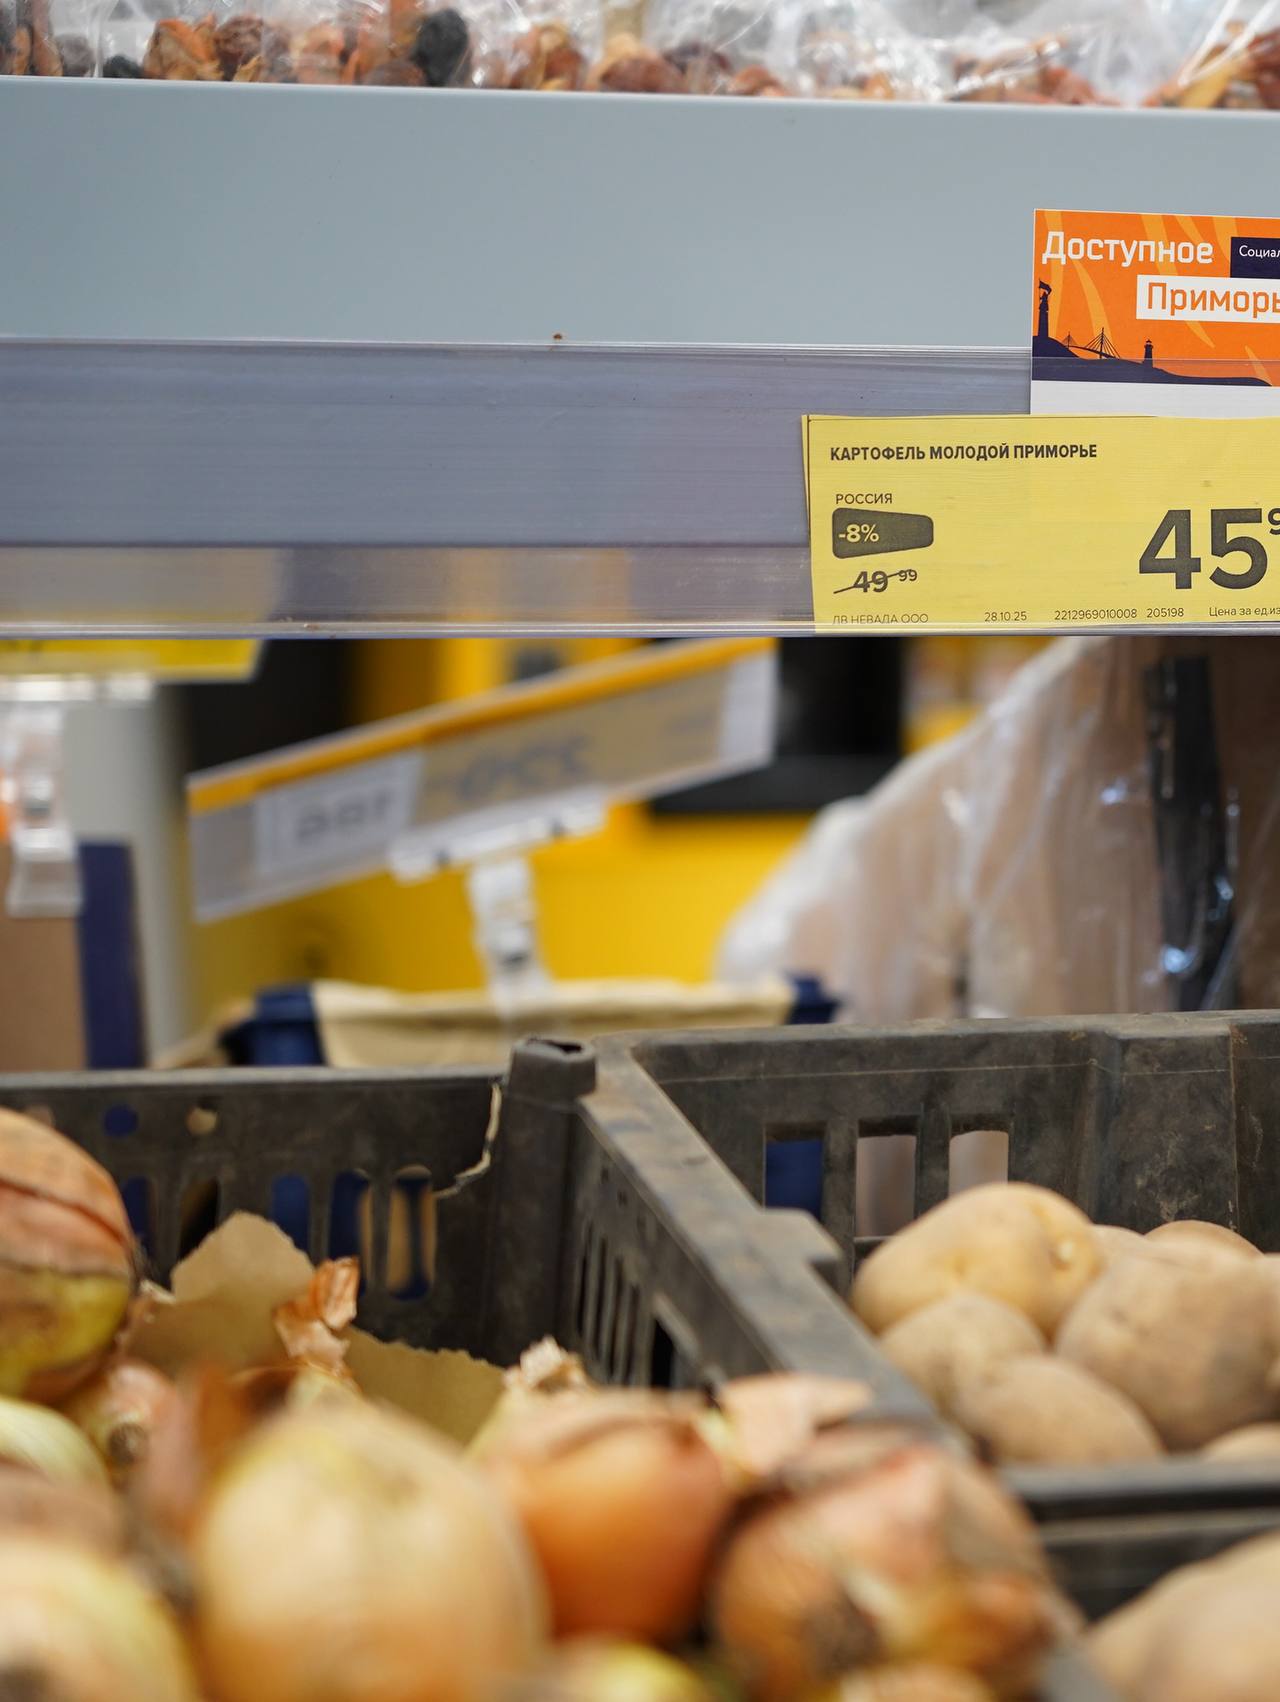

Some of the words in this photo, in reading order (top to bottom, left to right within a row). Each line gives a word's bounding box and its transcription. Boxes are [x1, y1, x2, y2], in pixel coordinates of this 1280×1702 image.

[1042, 231, 1214, 267] Доступное
[830, 446, 926, 461] КАРТОФЕЛЬ
[930, 443, 1010, 461] МОЛОДОЙ
[1013, 444, 1098, 459] ПРИМОРЬЕ
[835, 493, 892, 504] РОССИЯ
[838, 524, 880, 542] -8%
[851, 615, 898, 624] НЕВАДА
[901, 613, 929, 624] ООО
[984, 611, 1027, 622] 28.10.25
[1054, 608, 1138, 621] 2212969010008
[1146, 607, 1185, 618] 205198
[1209, 607, 1236, 618] Цена
[1239, 608, 1251, 616] за
